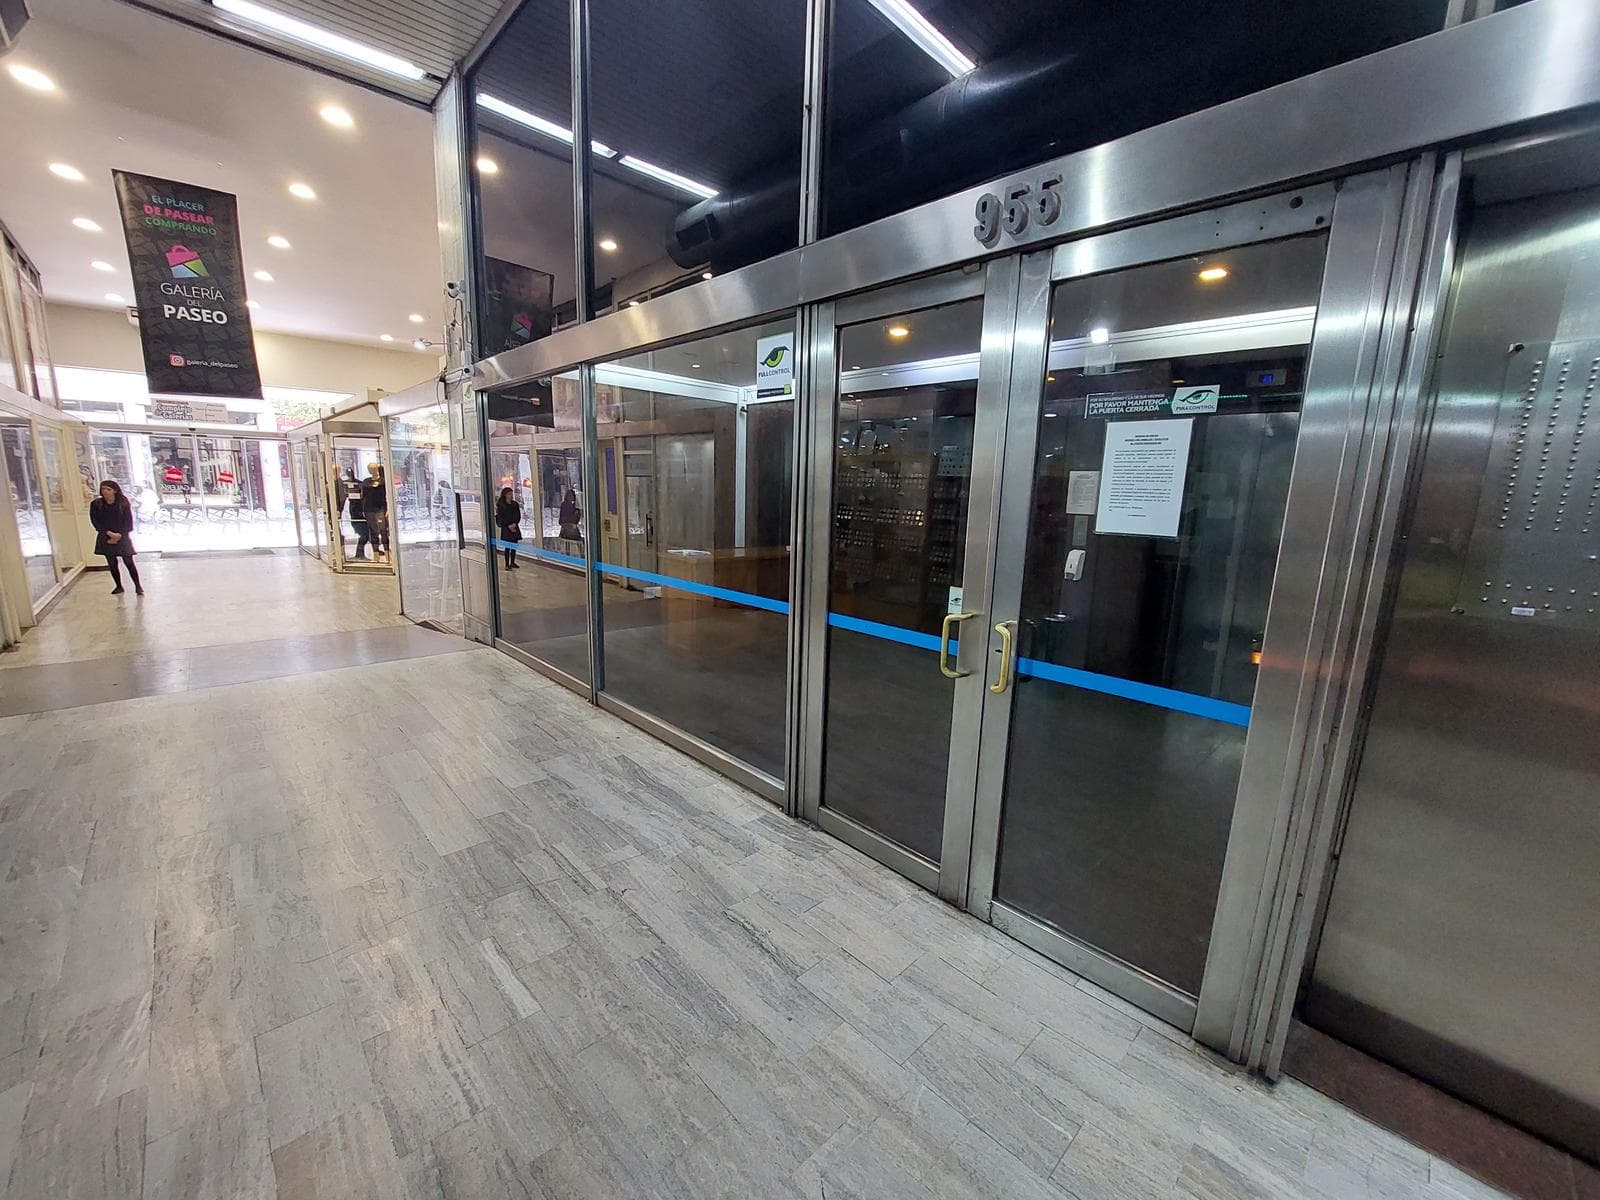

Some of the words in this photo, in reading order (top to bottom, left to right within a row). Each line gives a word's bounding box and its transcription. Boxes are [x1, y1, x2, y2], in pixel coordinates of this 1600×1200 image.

[152, 195, 165, 205] EL
[166, 197, 205, 212] PLACER
[974, 174, 1064, 245] 955
[143, 204, 162, 216] DE
[164, 207, 215, 225] PASEAR
[145, 216, 218, 236] COMPRANDO
[160, 282, 226, 302] GALERÍA
[187, 299, 203, 308] DEL
[163, 304, 229, 325] PASEO
[1104, 400, 1127, 408] FAVOR
[1127, 398, 1169, 406] MANTENGA
[1125, 405, 1160, 413] CERRADA
